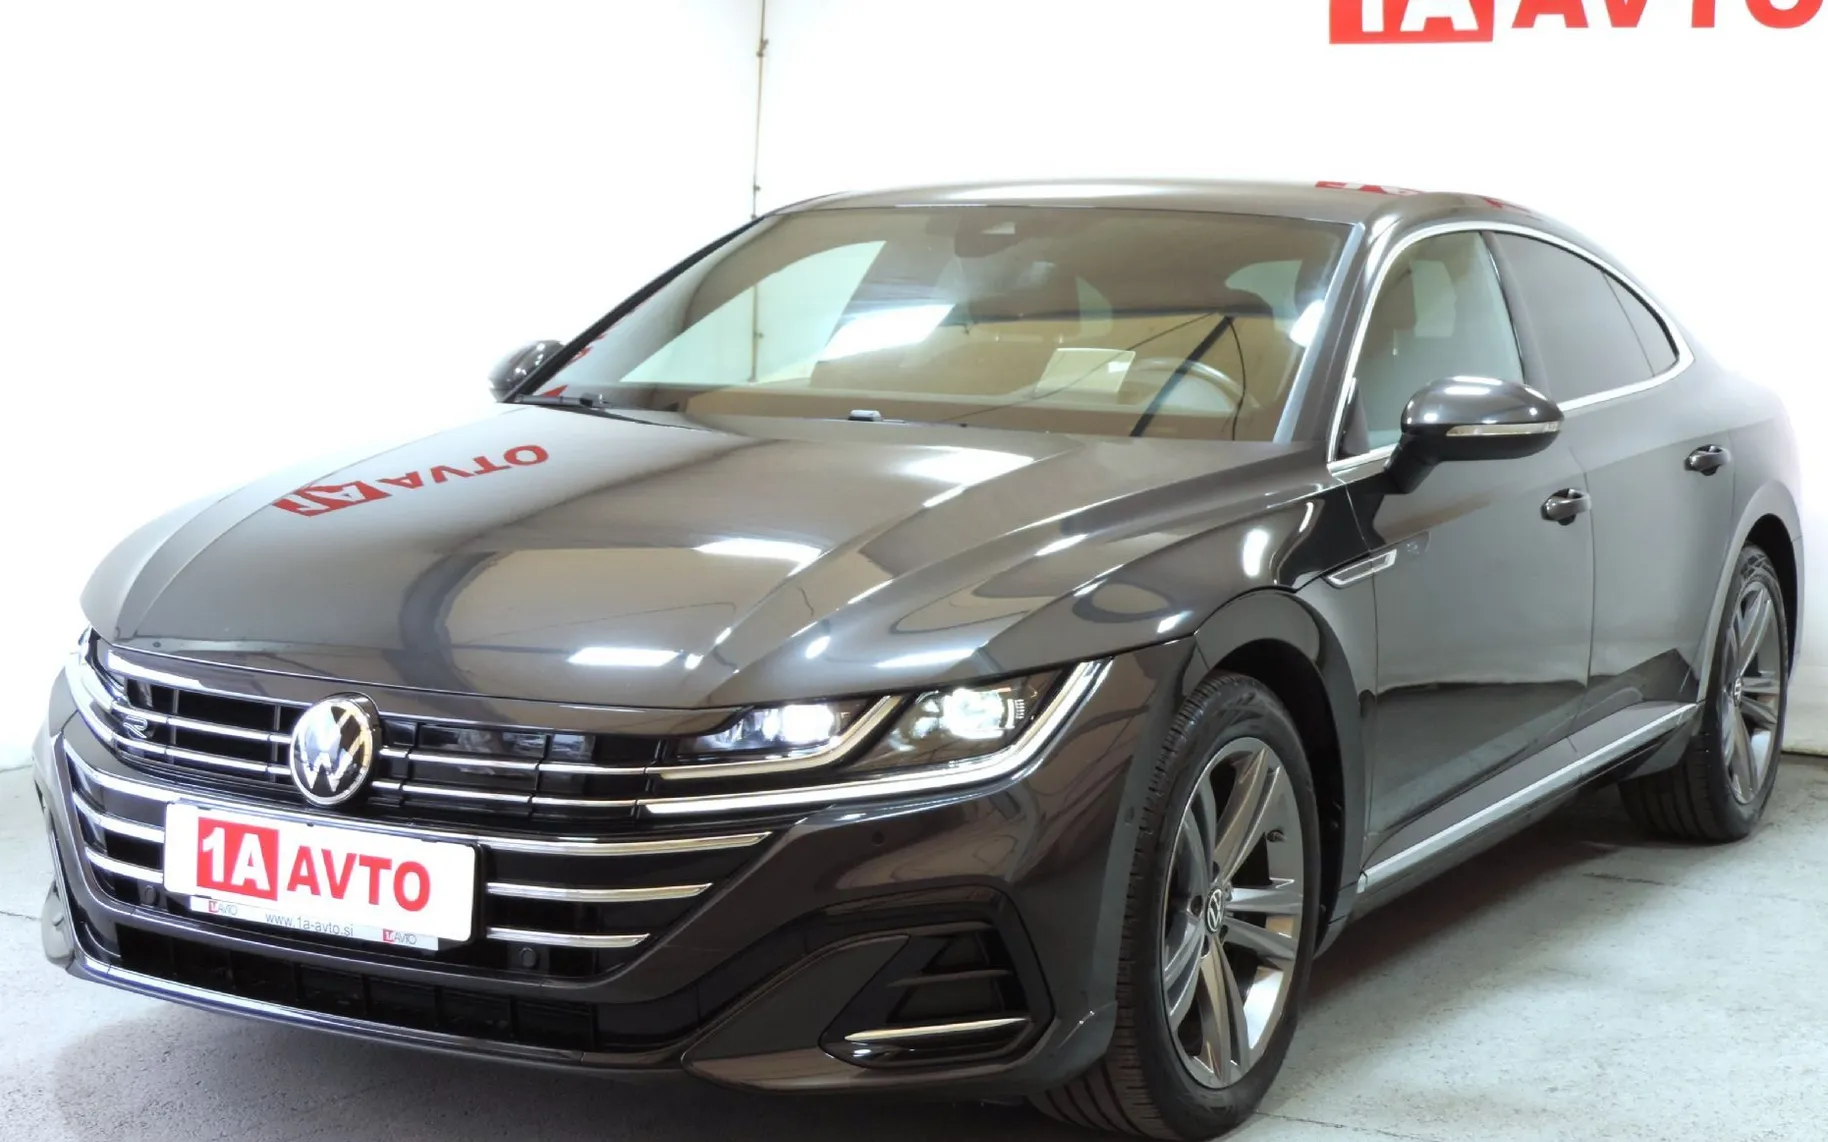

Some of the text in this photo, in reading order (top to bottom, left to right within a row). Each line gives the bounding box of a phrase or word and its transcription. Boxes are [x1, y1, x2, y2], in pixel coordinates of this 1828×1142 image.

[202, 826, 431, 912] 1A AVTO
[265, 911, 354, 937] www.1a-avto.si
